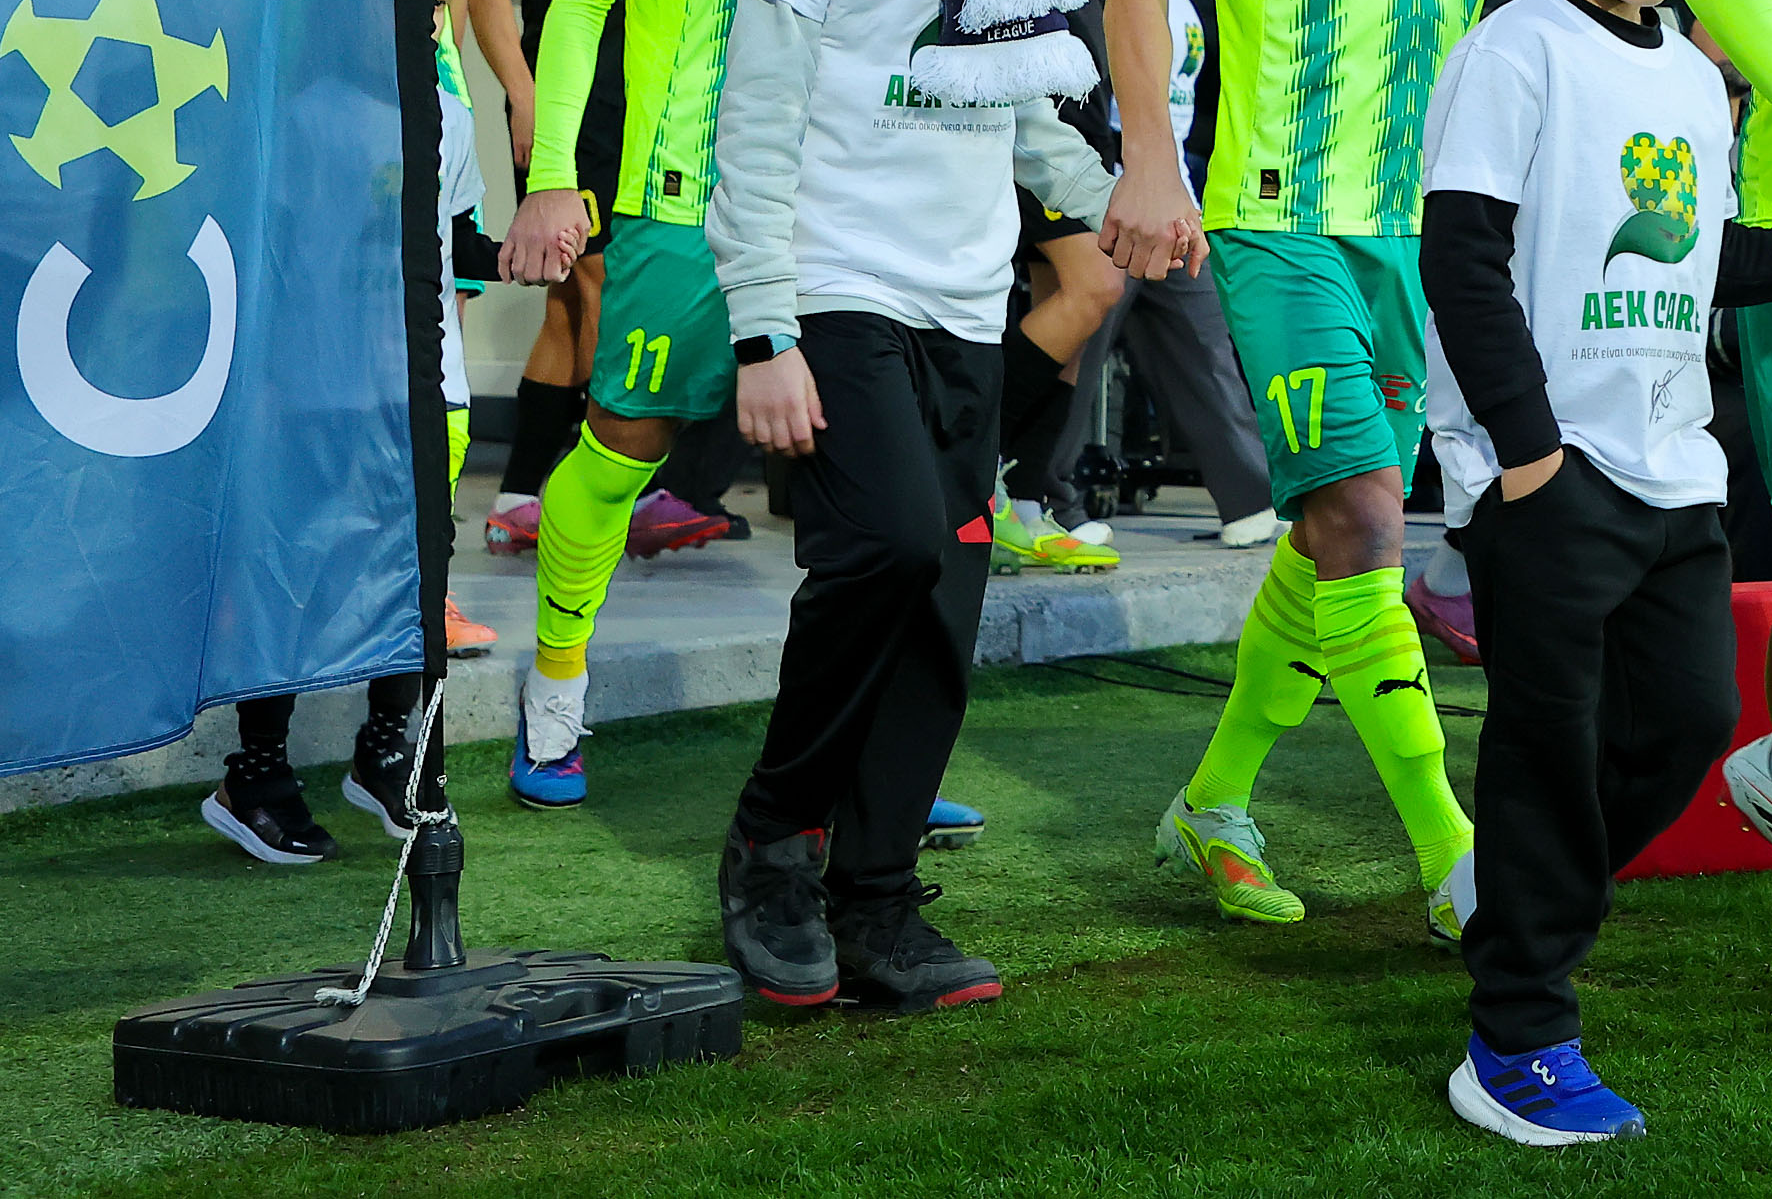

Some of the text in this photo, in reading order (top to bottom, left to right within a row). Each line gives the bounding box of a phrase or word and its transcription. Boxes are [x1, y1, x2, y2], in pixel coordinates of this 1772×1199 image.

[987, 19, 1035, 42] LEAGUE
[1581, 290, 1649, 331] AEK
[625, 327, 672, 394] 11
[1266, 366, 1327, 454] 17
